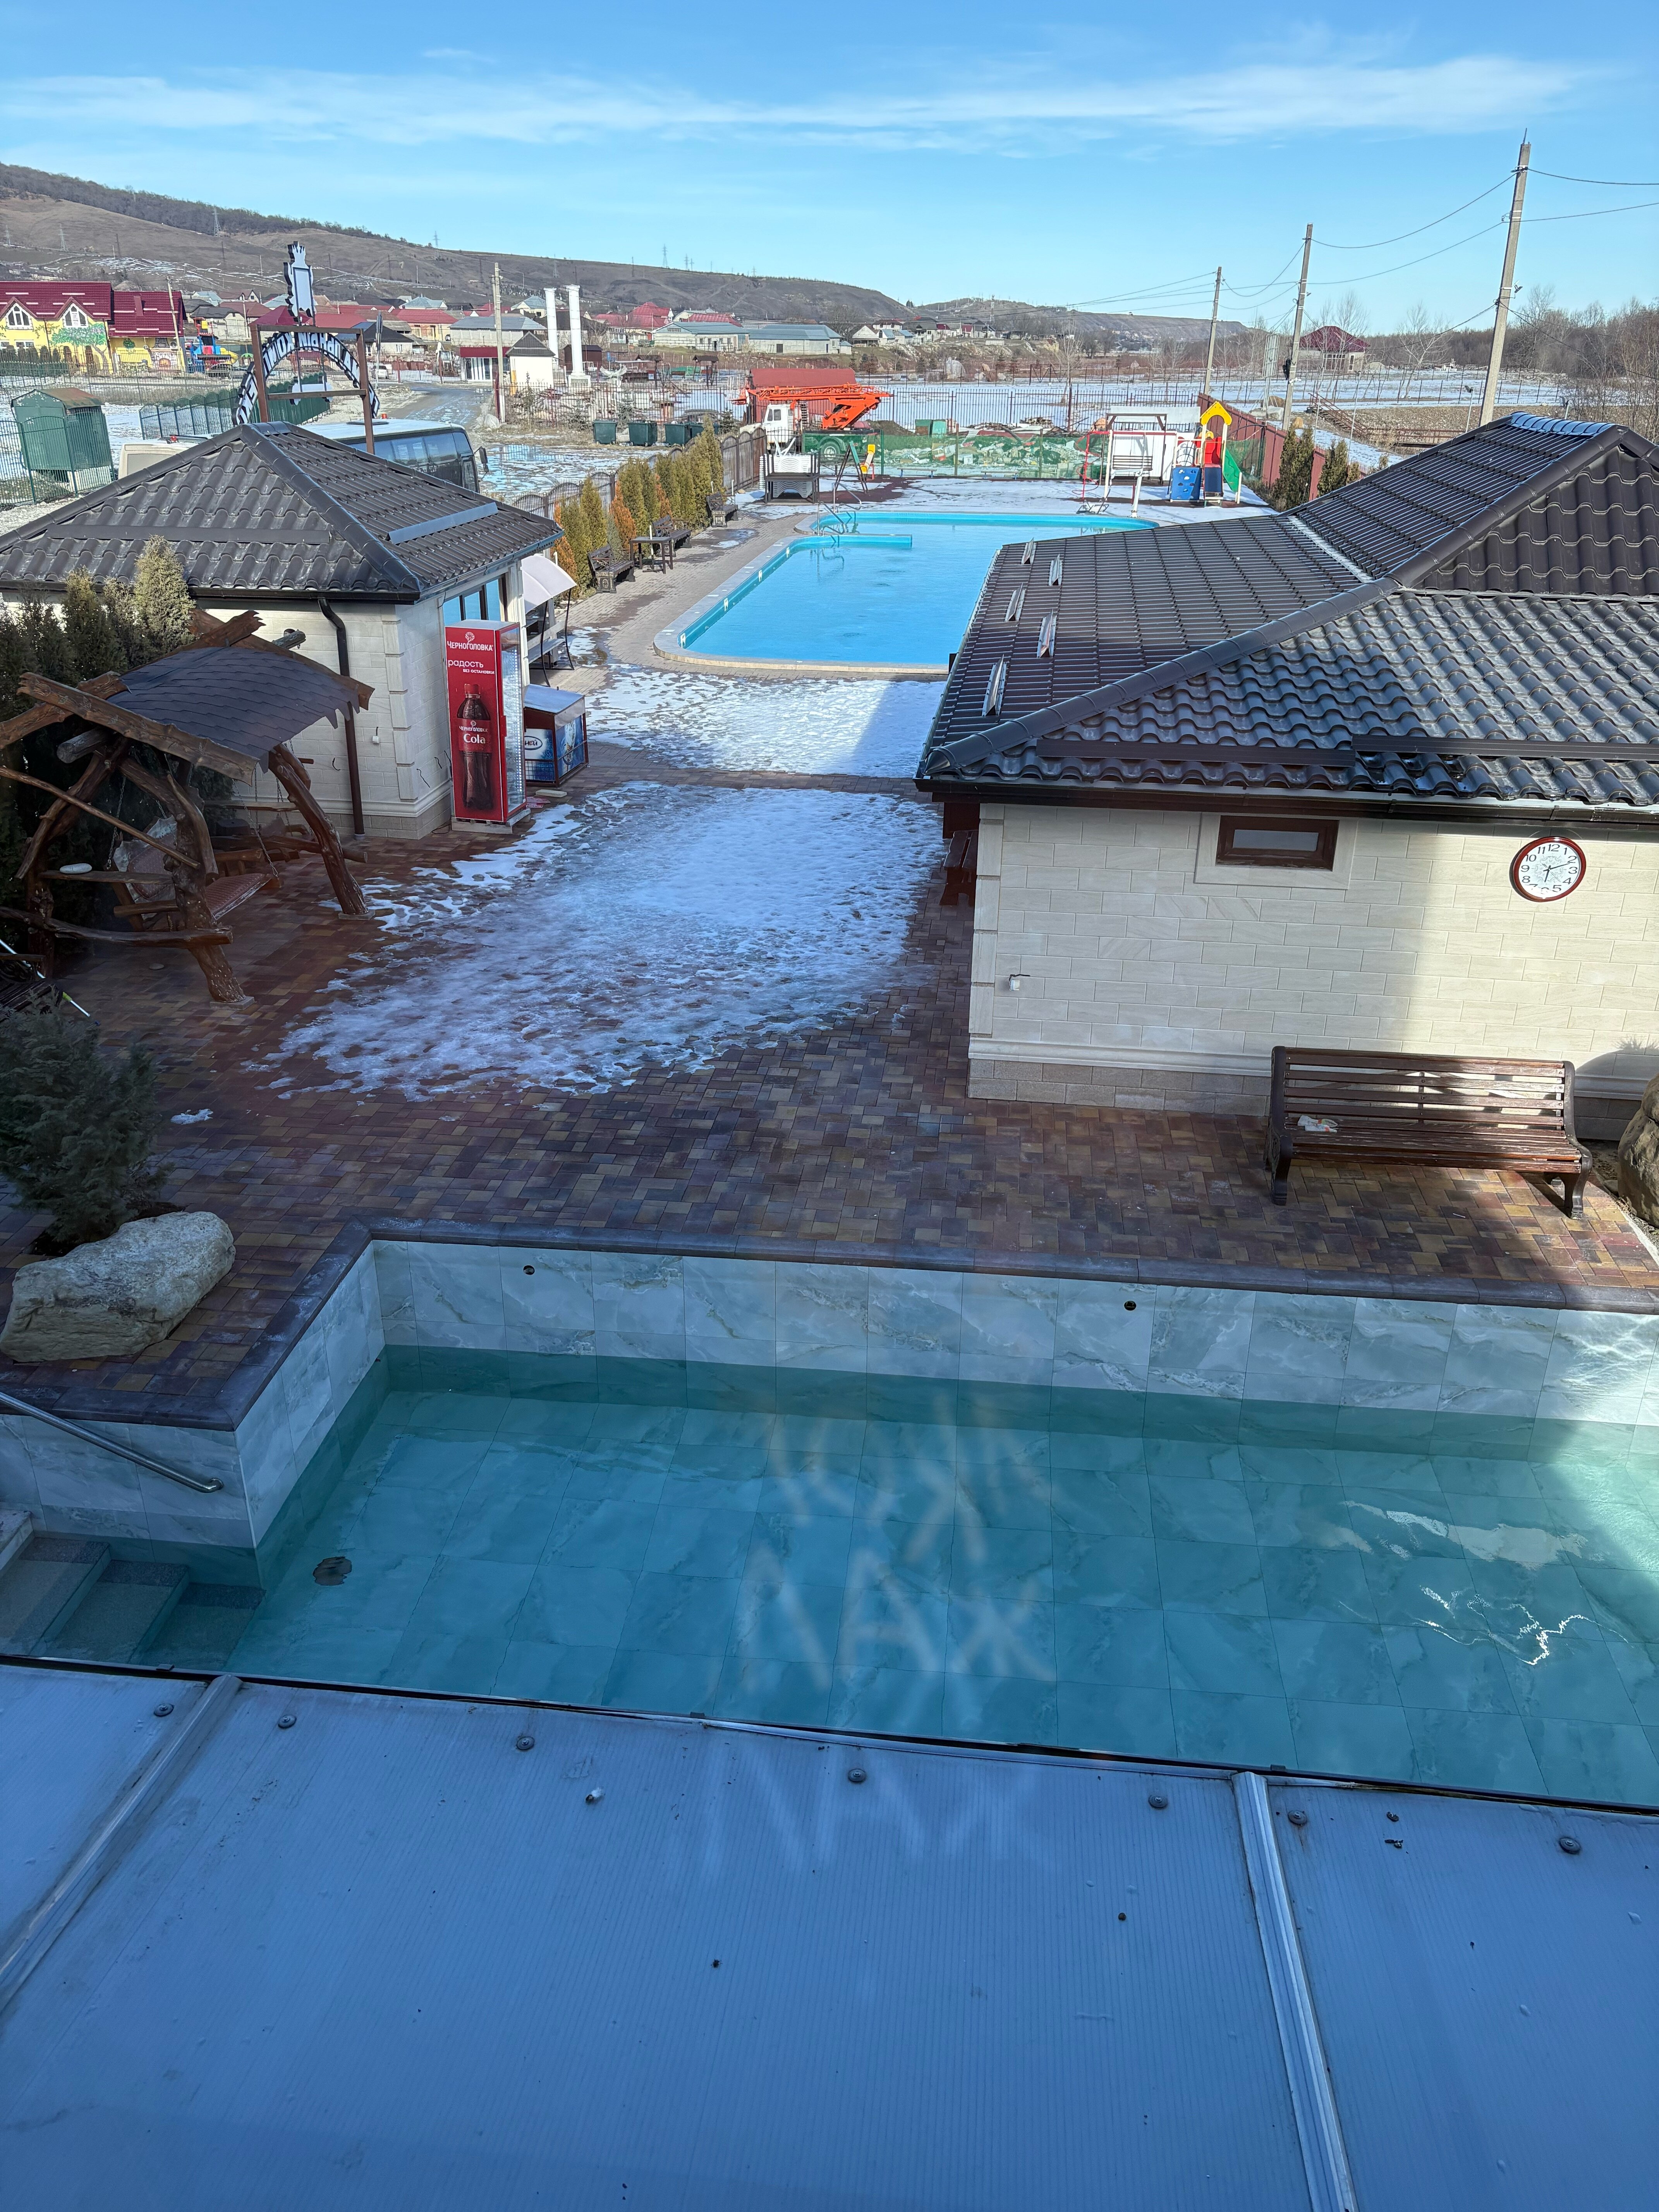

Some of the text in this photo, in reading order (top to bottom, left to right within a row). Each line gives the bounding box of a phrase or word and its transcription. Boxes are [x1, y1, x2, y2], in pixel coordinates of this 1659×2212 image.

[447, 641, 493, 651] ЧЕРНОГОЛОВКА
[448, 660, 484, 668] радость
[463, 733, 486, 744] Cola
